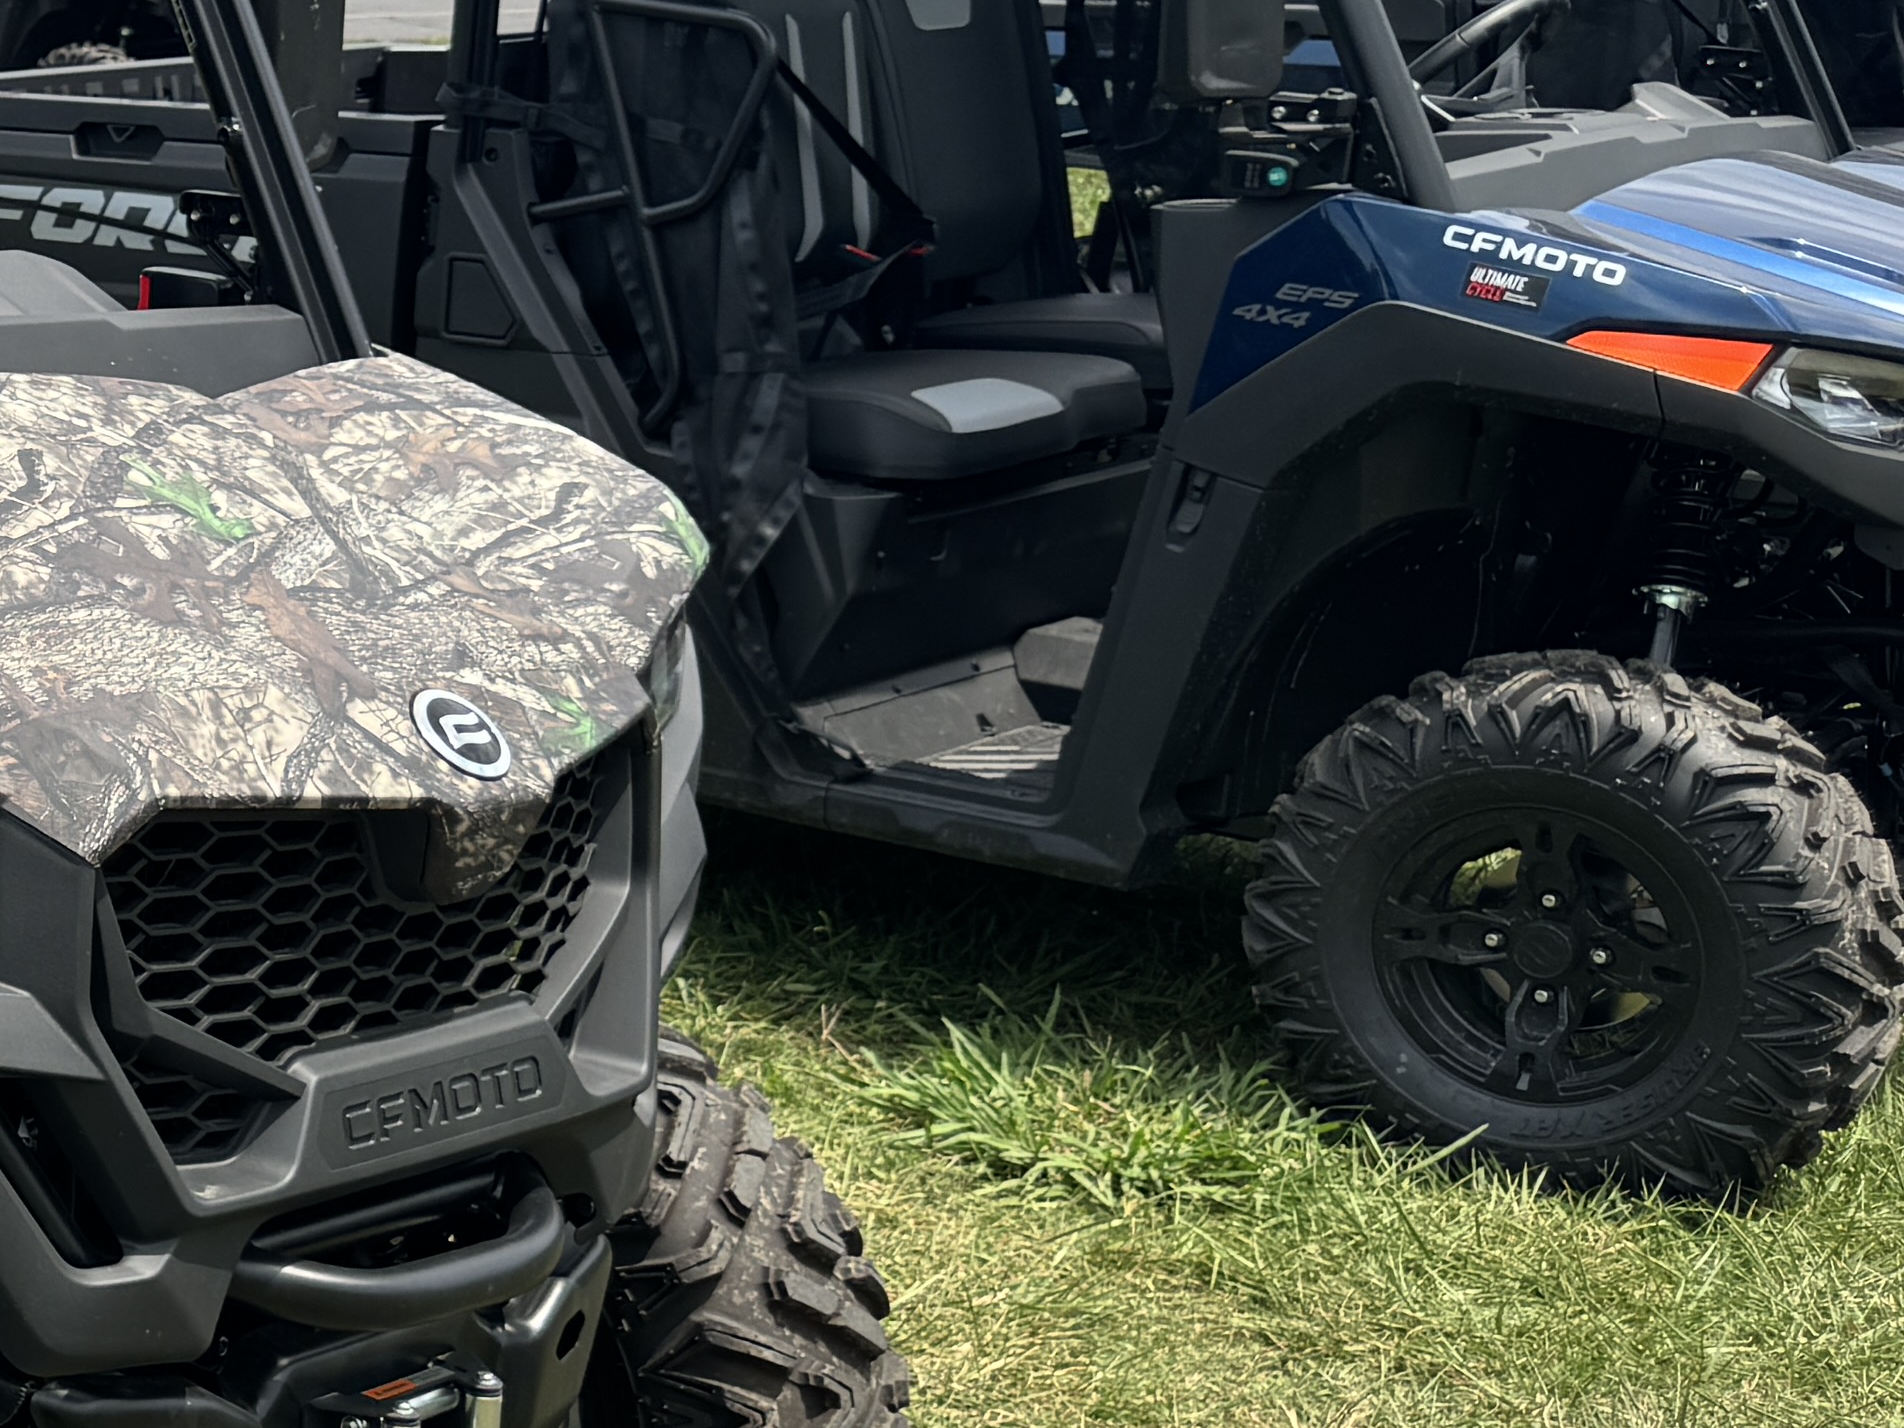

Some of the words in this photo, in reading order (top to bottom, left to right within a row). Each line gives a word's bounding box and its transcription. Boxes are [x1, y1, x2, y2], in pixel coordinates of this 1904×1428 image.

[1442, 223, 1627, 288] CFMOTO
[1469, 266, 1529, 293] ULTIMATE
[1275, 282, 1361, 309] EPS
[1232, 301, 1313, 330] 4X4
[342, 1056, 544, 1151] CFMOTO
